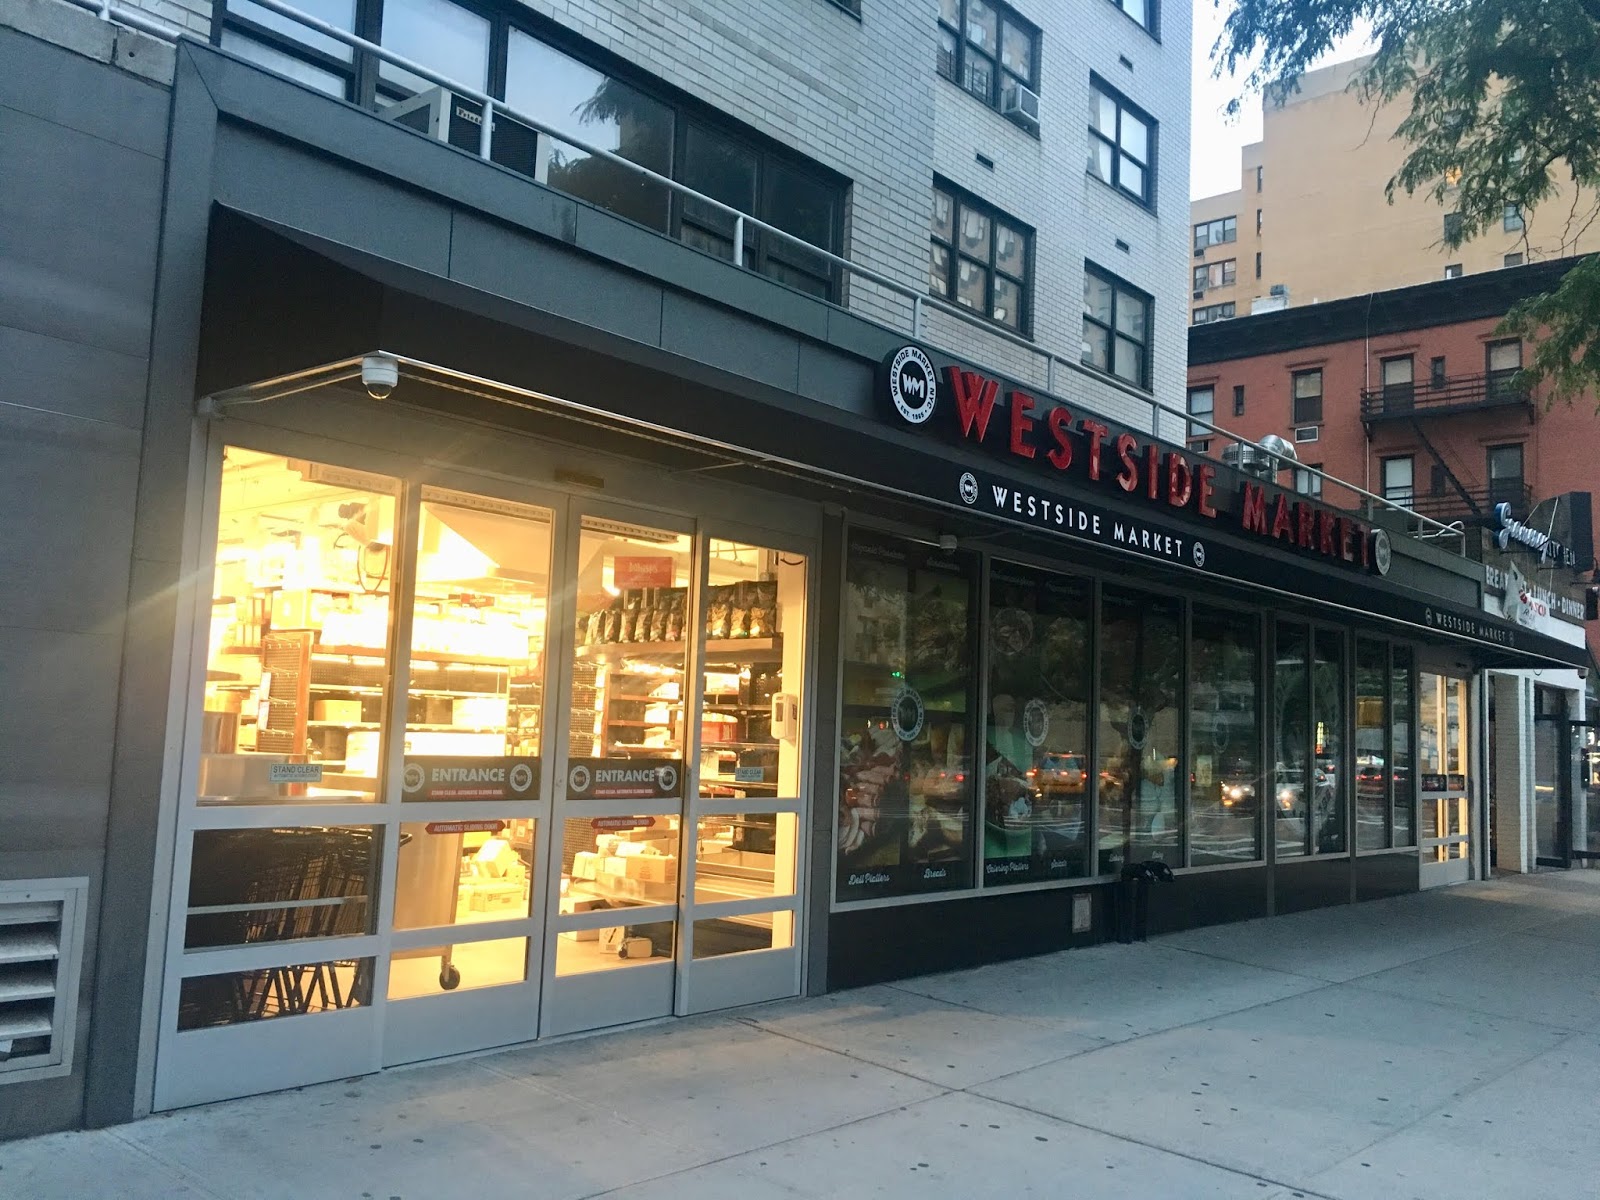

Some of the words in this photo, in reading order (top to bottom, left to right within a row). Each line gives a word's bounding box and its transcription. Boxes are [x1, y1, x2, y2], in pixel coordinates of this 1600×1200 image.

[892, 349, 910, 397] WESTSIDE
[911, 349, 935, 383] MARKET
[926, 387, 936, 410] NYC
[902, 373, 925, 399] WM
[946, 365, 1217, 519] WESTSIDE
[1242, 481, 1371, 568] MARKET
[992, 485, 1101, 535] WESTSIDE
[1114, 521, 1183, 557] MARKET
[1561, 596, 1584, 620] DINNER
[1435, 612, 1475, 634] WESTSIDE
[1479, 624, 1506, 641] MARKET
[273, 765, 296, 774] STAND
[297, 766, 319, 774] CLEAR
[431, 768, 505, 782] ENTRANCE
[595, 769, 655, 782] ENTRANCE
[433, 824, 463, 832] AUTOMATIC
